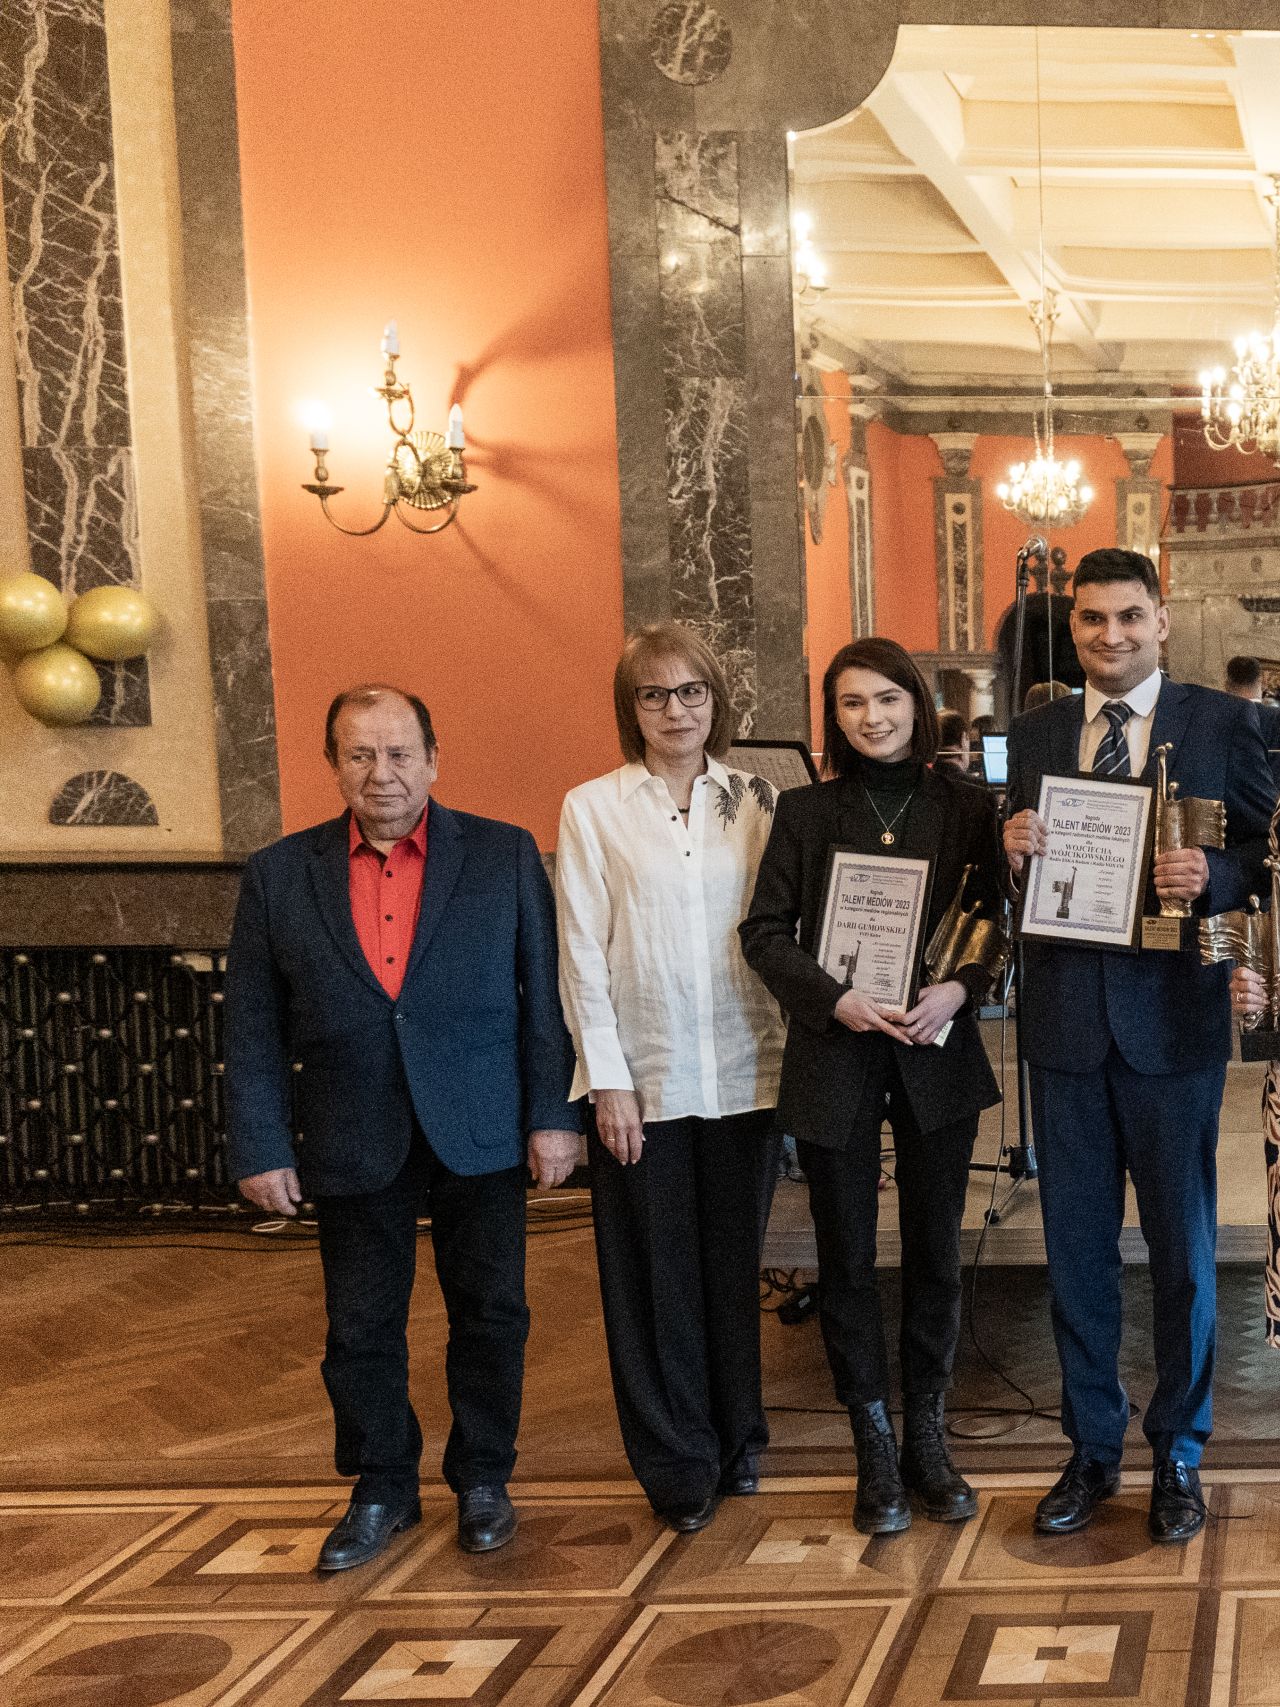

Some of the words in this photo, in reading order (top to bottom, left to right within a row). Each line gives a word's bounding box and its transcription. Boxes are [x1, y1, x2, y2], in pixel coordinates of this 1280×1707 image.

[1052, 819, 1079, 830] TALENT
[1081, 820, 1112, 833] MEDIÓW
[1051, 848, 1125, 863] WÓJCIKOWSKIEGO
[1065, 844, 1112, 855] WOJCIECHA
[841, 894, 865, 905] TALENT
[866, 896, 893, 908] MEDIÓW
[837, 921, 857, 930] DARII
[858, 923, 906, 934] GUMOWSKIEJ
